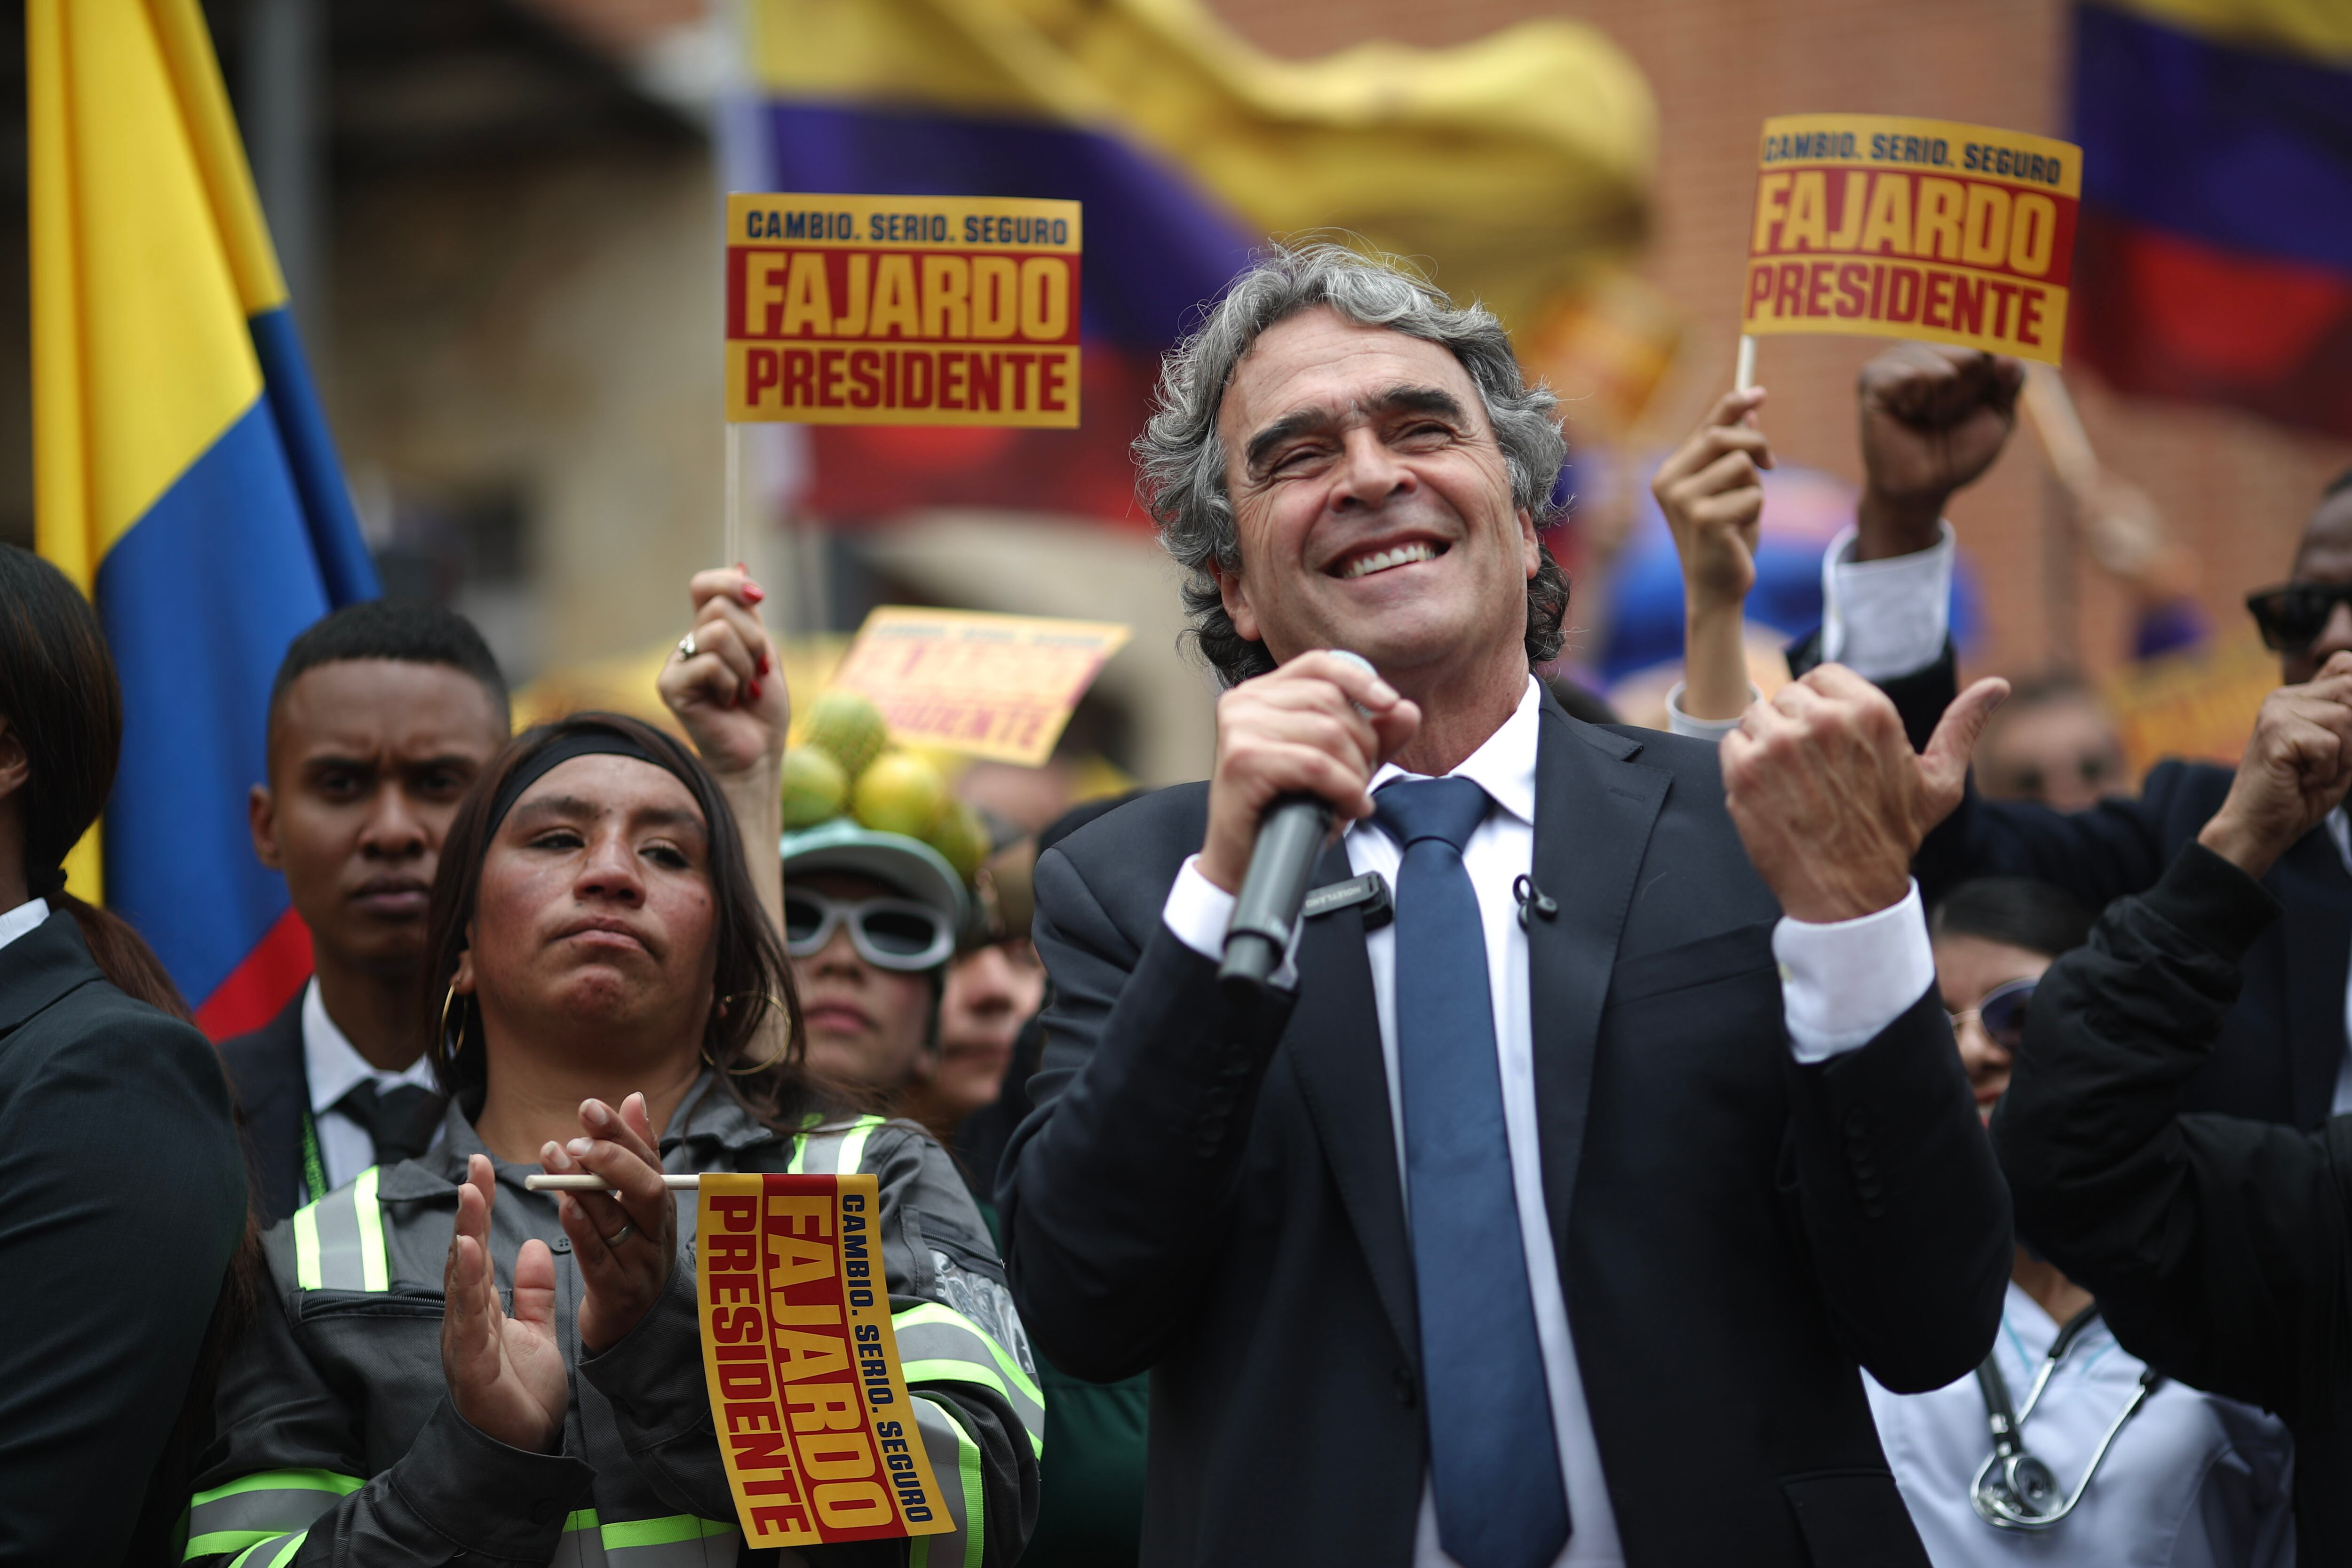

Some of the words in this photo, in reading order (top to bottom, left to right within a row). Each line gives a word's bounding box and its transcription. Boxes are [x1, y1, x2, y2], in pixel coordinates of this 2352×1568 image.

[1763, 131, 1862, 163] CAMBIO.
[1870, 134, 1955, 168] SERIO.
[1963, 142, 2062, 185] SEGURO
[746, 210, 861, 240] CAMBIO.
[869, 212, 955, 243] SERIO.
[964, 215, 1068, 245] SEGURO
[1752, 170, 2058, 277] FAJARDO
[745, 251, 1070, 341] FAJARDO
[1747, 261, 2046, 347] PRESIDENTE
[746, 348, 1067, 412] PRESIDENTE
[842, 1194, 874, 1316] CAMBIO.
[708, 1195, 811, 1536] PRESIDENTE
[767, 1195, 894, 1529] FAJARDO
[855, 1324, 894, 1413] SERIO.
[877, 1420, 934, 1523] SEGURO
